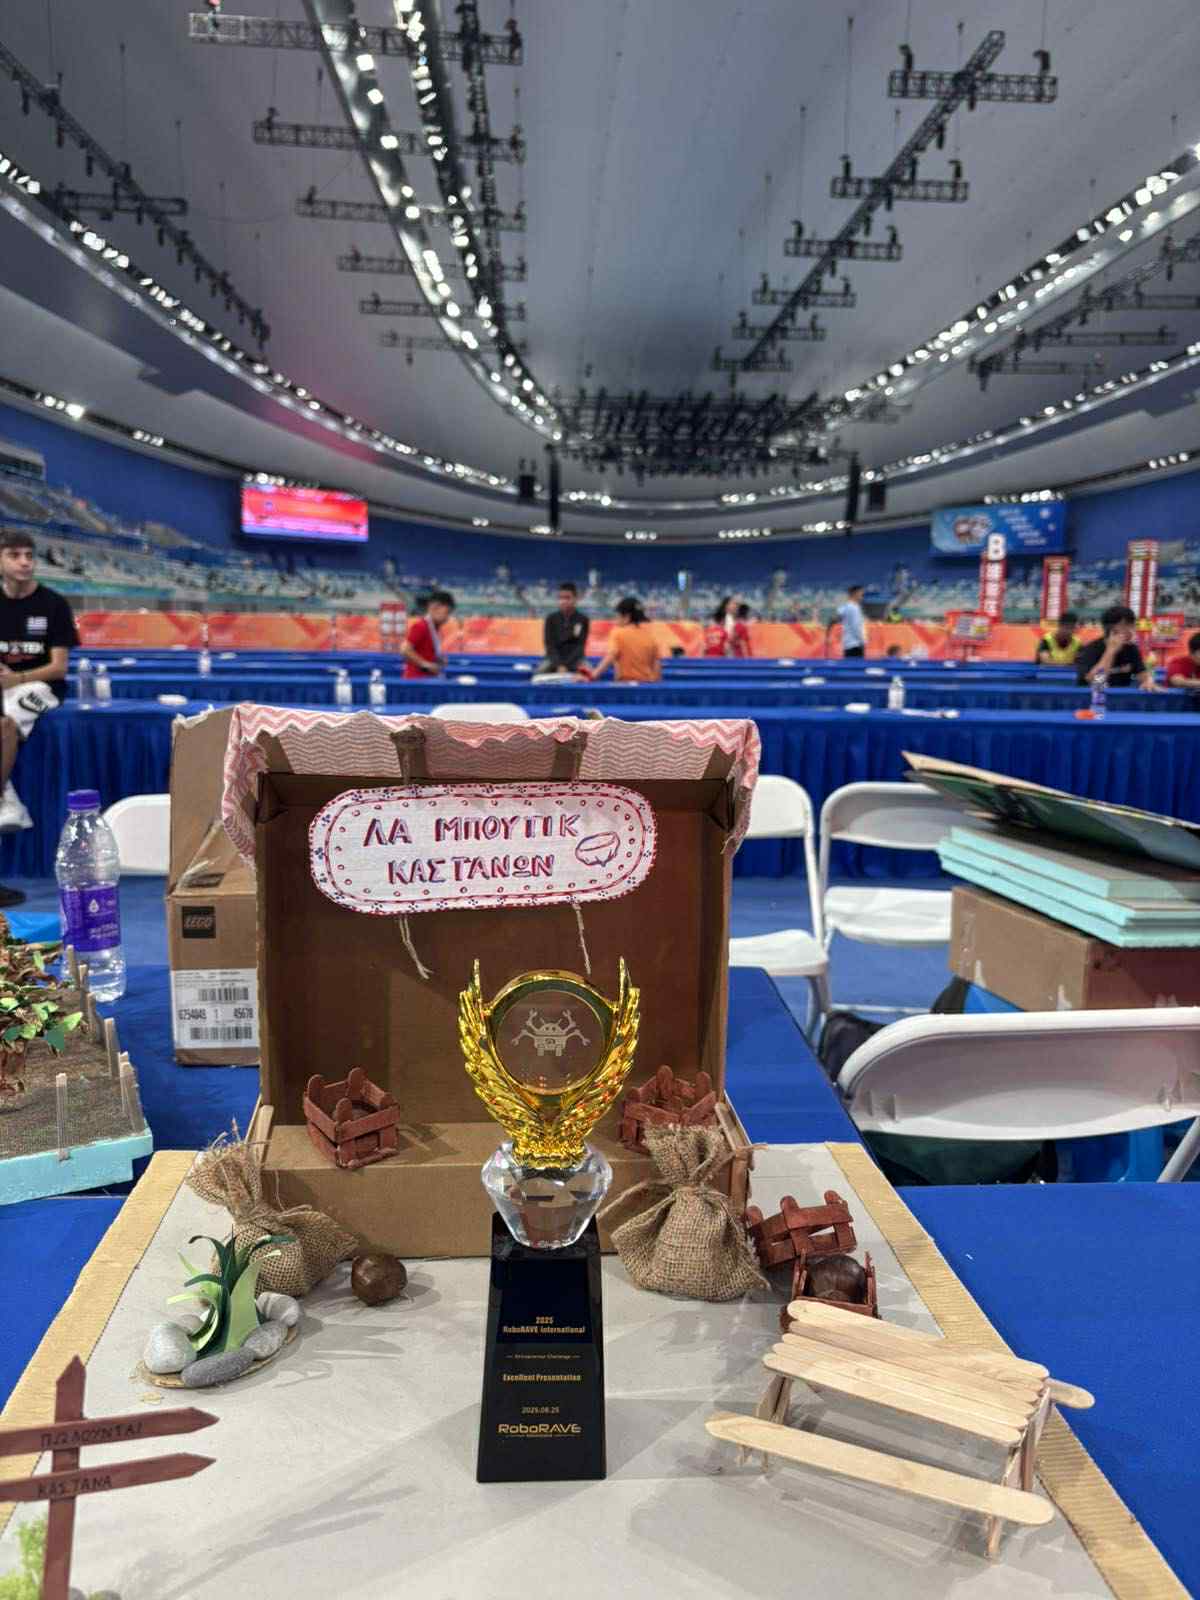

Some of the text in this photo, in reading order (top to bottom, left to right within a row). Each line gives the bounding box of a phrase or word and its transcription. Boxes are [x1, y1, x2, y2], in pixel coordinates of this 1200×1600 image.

[363, 814, 581, 846] ΛΑ ΜΠΟΥΤΙΚ
[387, 854, 555, 884] ΚΑΣΤΑΝΩΝ
[183, 915, 213, 929] LEGO
[535, 1316, 554, 1324] 2025
[503, 1326, 585, 1334] RoboRAVE International
[498, 1423, 581, 1433] RoboRAVE
[38, 1475, 113, 1499] ΚΑΣΤΑΝΑ
